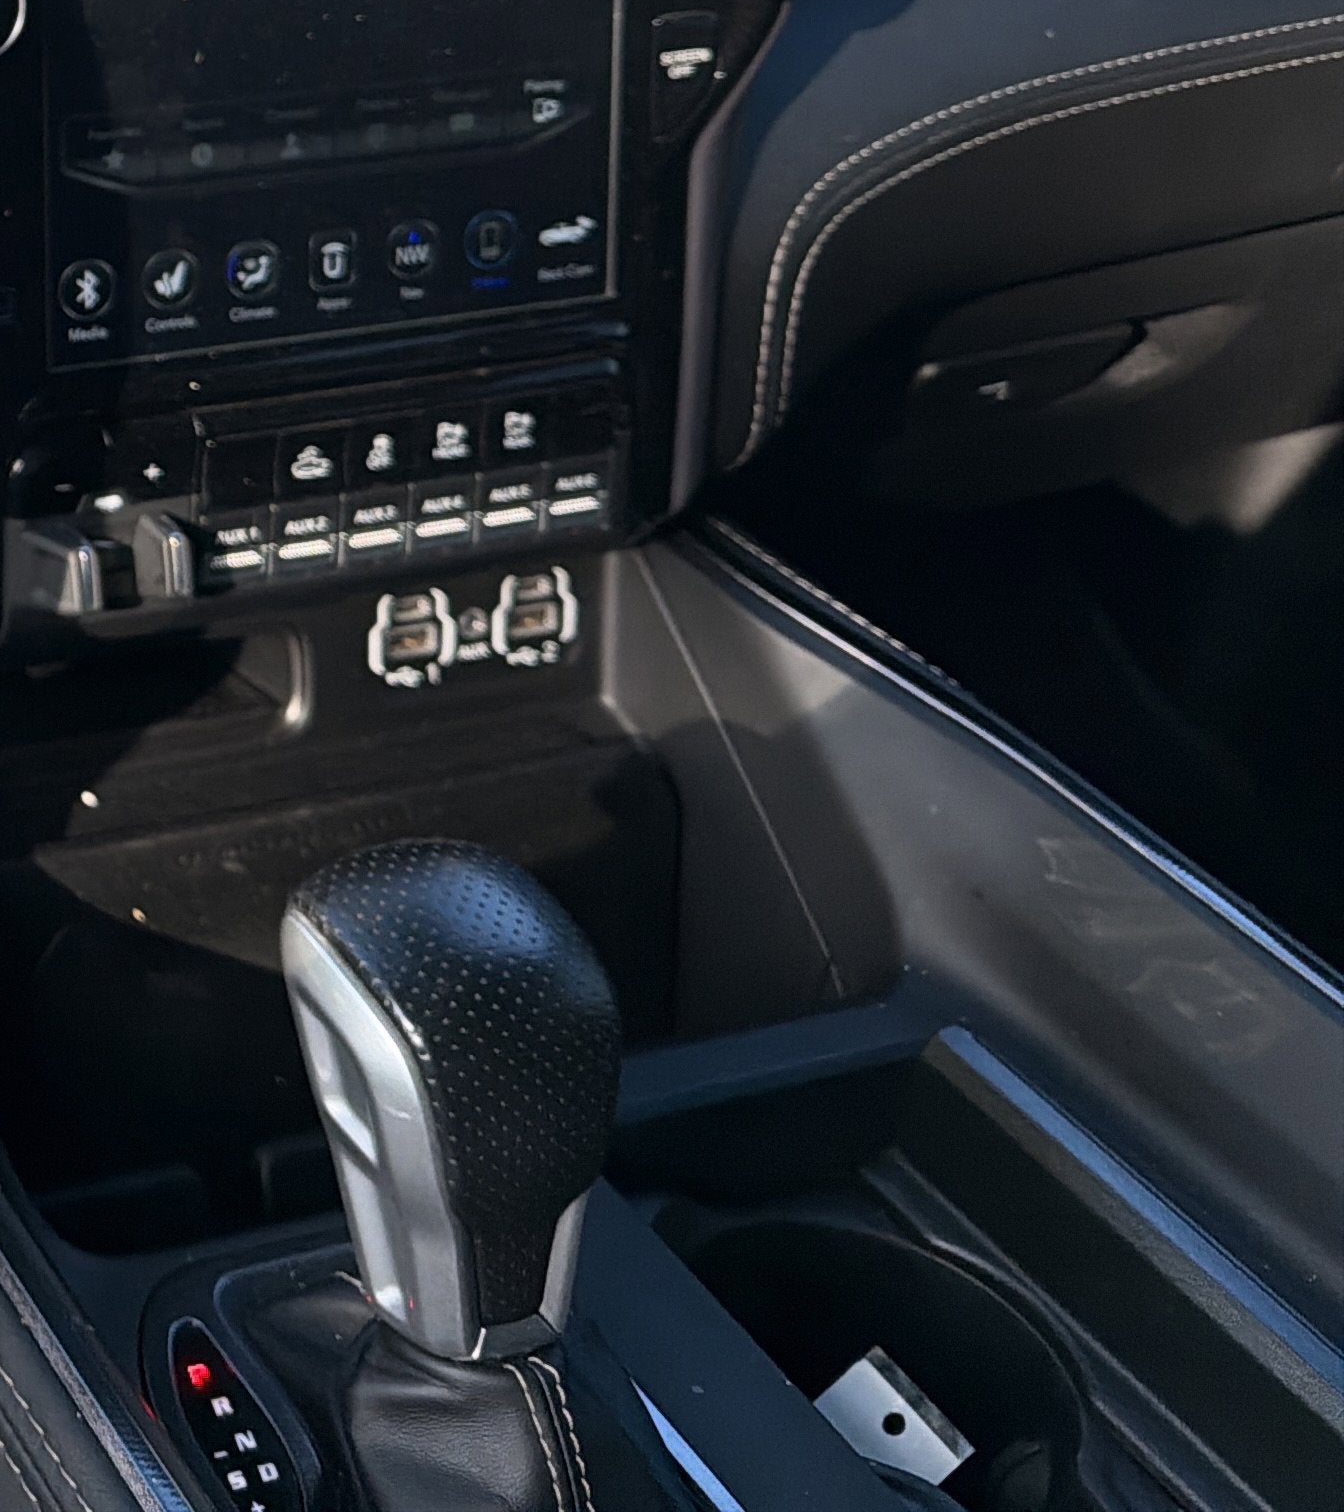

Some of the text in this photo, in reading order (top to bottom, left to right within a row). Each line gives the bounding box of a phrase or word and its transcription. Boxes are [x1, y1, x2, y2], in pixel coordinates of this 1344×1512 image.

[210, 1396, 235, 1418] R
[233, 1430, 259, 1453] N
[226, 1470, 250, 1492] S
[256, 1463, 280, 1484] D
